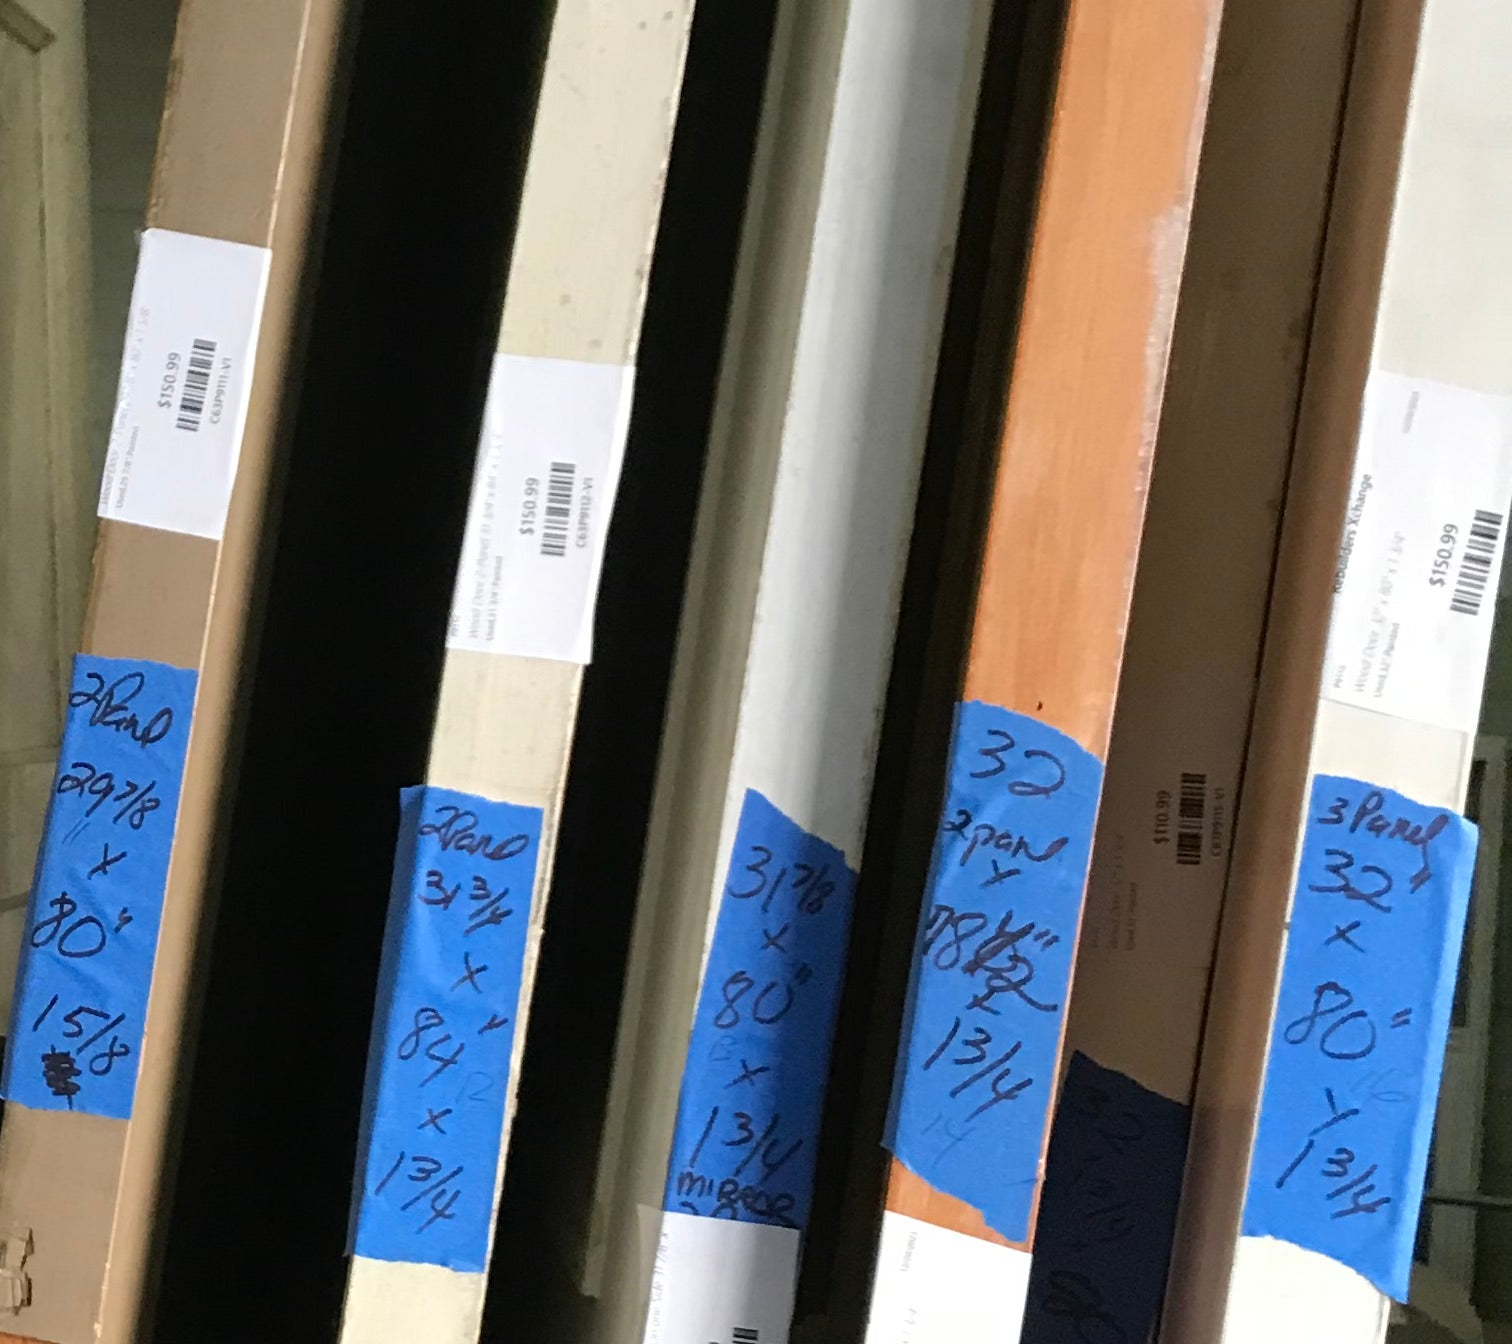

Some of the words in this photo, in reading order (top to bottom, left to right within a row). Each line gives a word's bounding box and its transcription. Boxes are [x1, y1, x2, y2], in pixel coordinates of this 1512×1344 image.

[157, 352, 181, 408] $150.99
[519, 477, 539, 536] $150.99
[1347, 474, 1373, 526] Xchange
[1428, 524, 1458, 588] $150.99
[57, 762, 115, 817] 29
[970, 729, 1066, 799] 32
[1153, 790, 1171, 844] $110.99
[727, 845, 787, 914] 31
